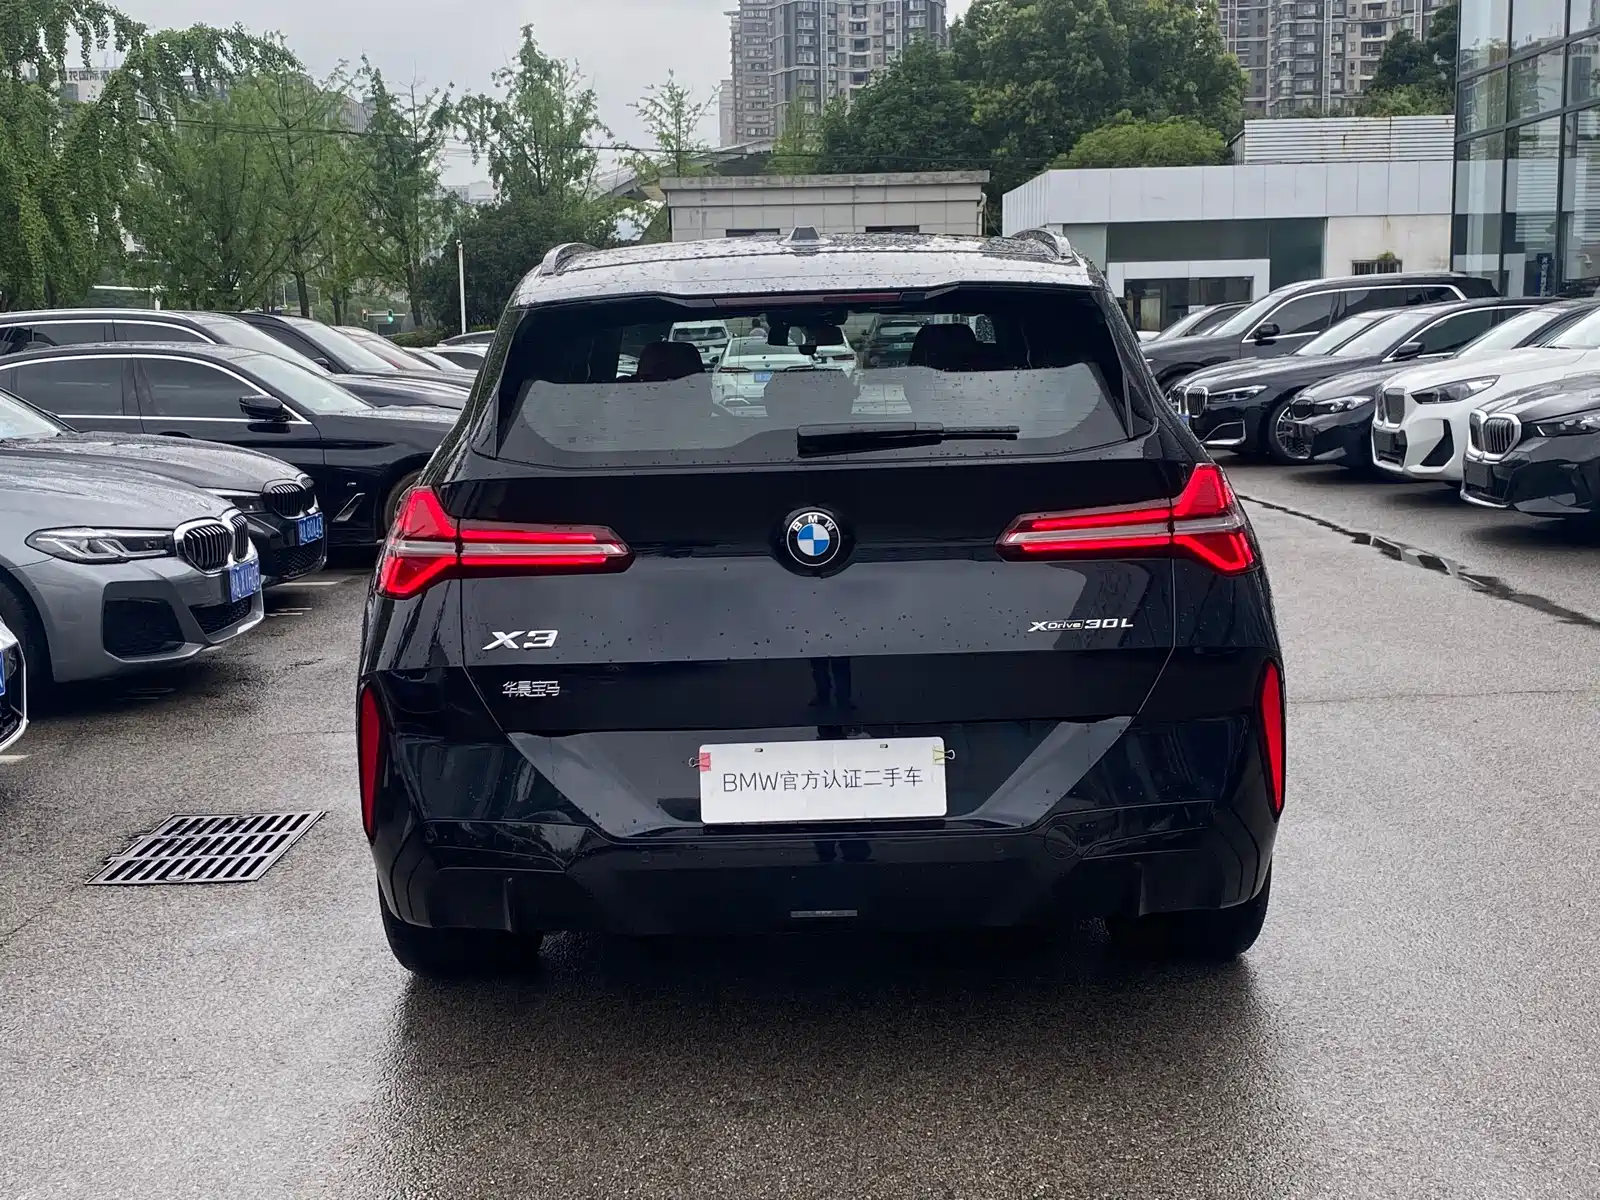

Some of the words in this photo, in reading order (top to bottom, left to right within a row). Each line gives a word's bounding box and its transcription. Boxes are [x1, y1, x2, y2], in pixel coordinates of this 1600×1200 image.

[792, 514, 835, 532] BMW
[482, 629, 559, 650] X3
[502, 680, 560, 697] 华晨宝马
[722, 766, 924, 792] BMW官方认证二手车
